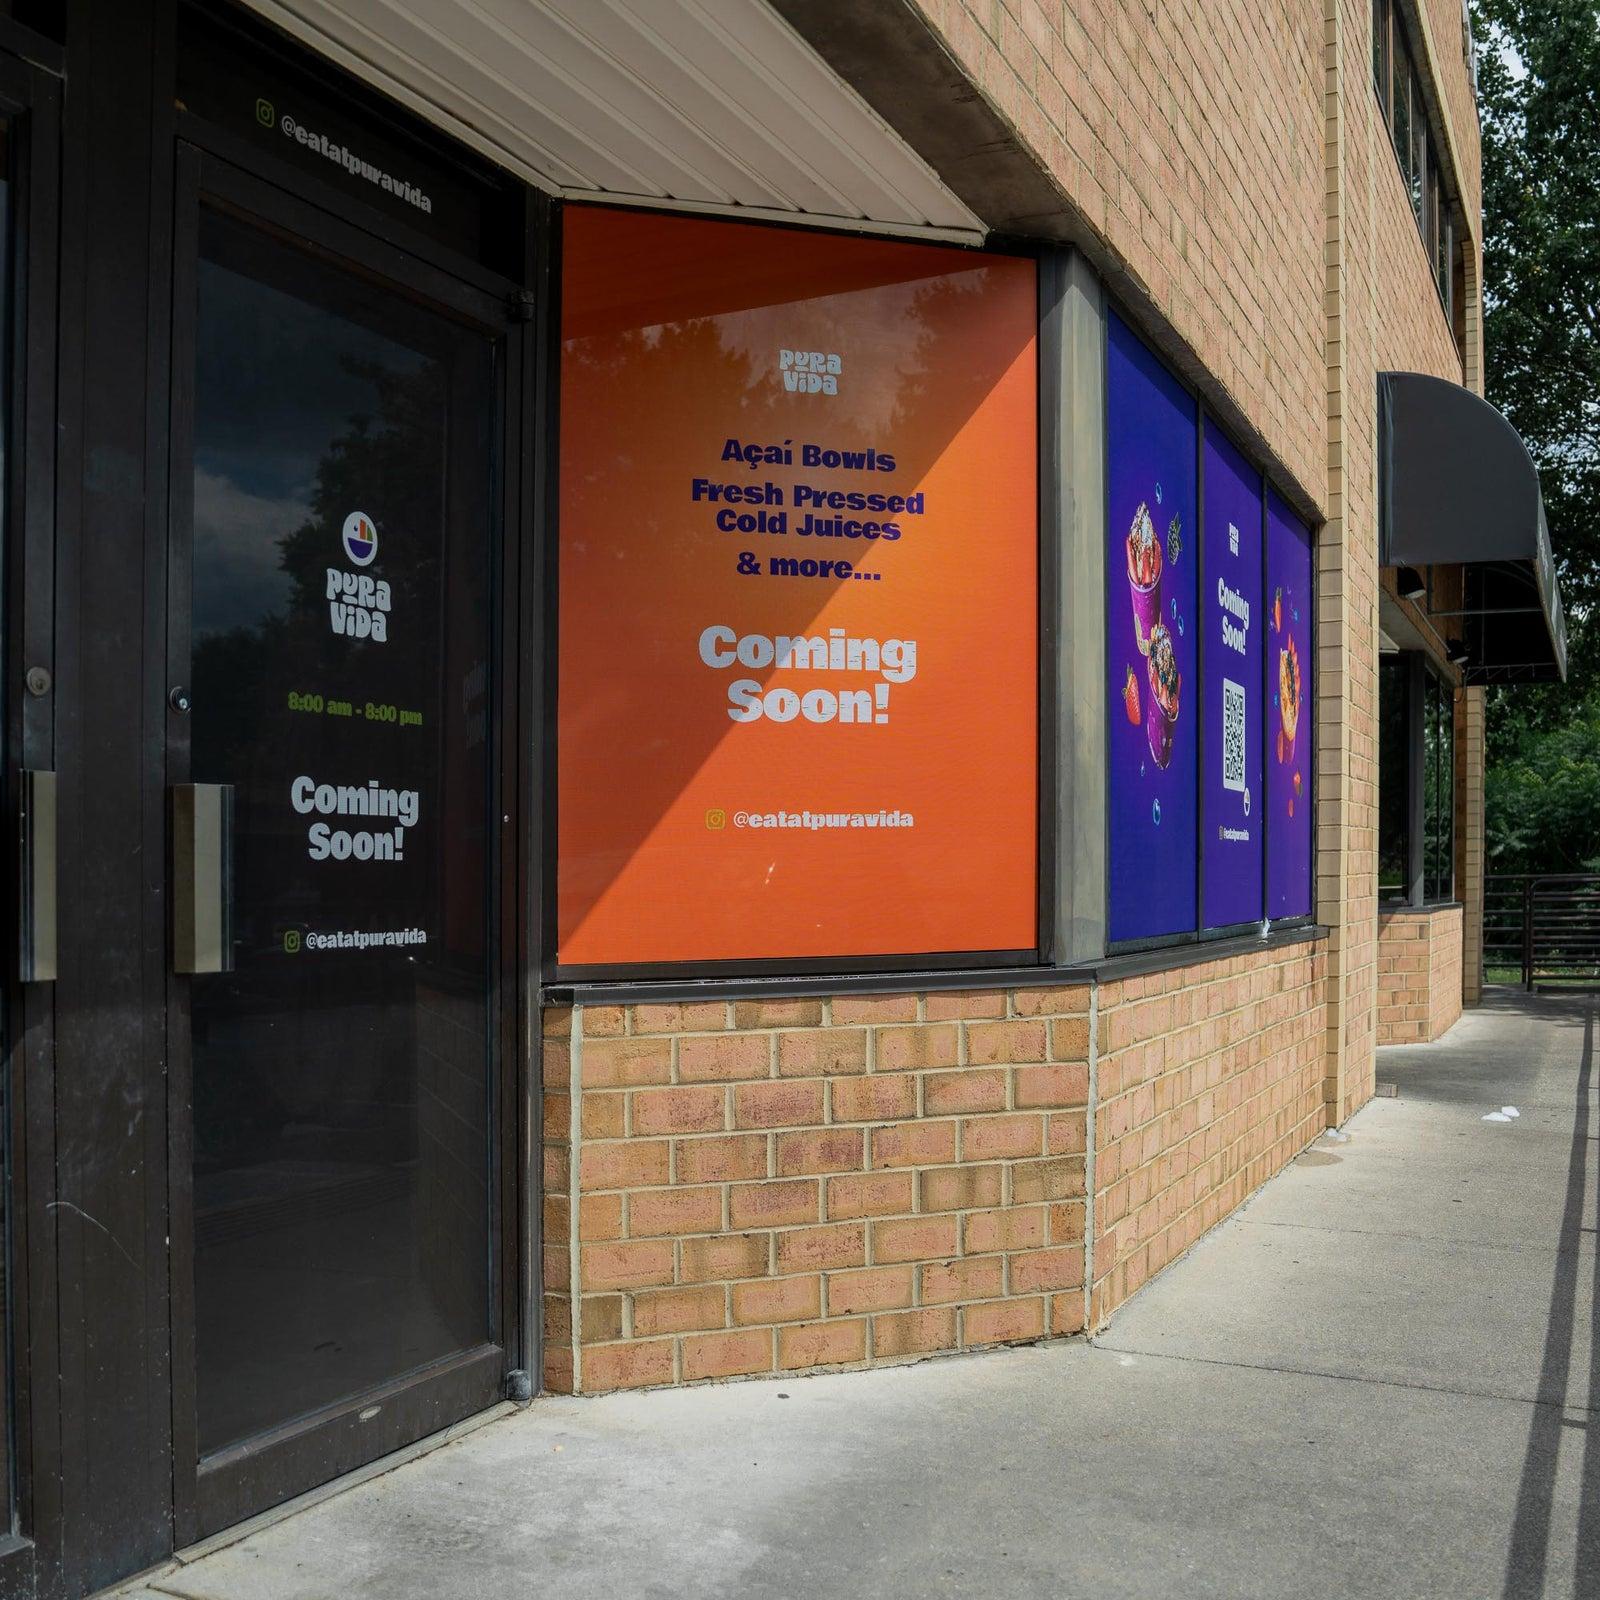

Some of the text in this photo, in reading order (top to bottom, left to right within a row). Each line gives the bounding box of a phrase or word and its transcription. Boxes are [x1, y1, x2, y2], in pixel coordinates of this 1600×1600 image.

[281, 115, 432, 214] @eatatpuravida
[721, 438, 897, 473] Açaí Bowls
[692, 478, 925, 515] Fresh Pressed
[716, 508, 902, 541] Cold Juices
[736, 551, 882, 581] & more...
[1217, 577, 1250, 631] Coming
[699, 625, 917, 684] Coming
[1222, 615, 1247, 656] Soon!
[287, 691, 324, 714] 8:00
[327, 700, 353, 717] am
[365, 702, 397, 722] 8:00
[399, 710, 423, 726] pm
[727, 678, 890, 724] Soon!
[291, 775, 419, 827] Coming
[733, 810, 914, 831] @eatatpuravida
[308, 822, 404, 861] Soon!
[306, 928, 427, 949] @eatatpuravida
